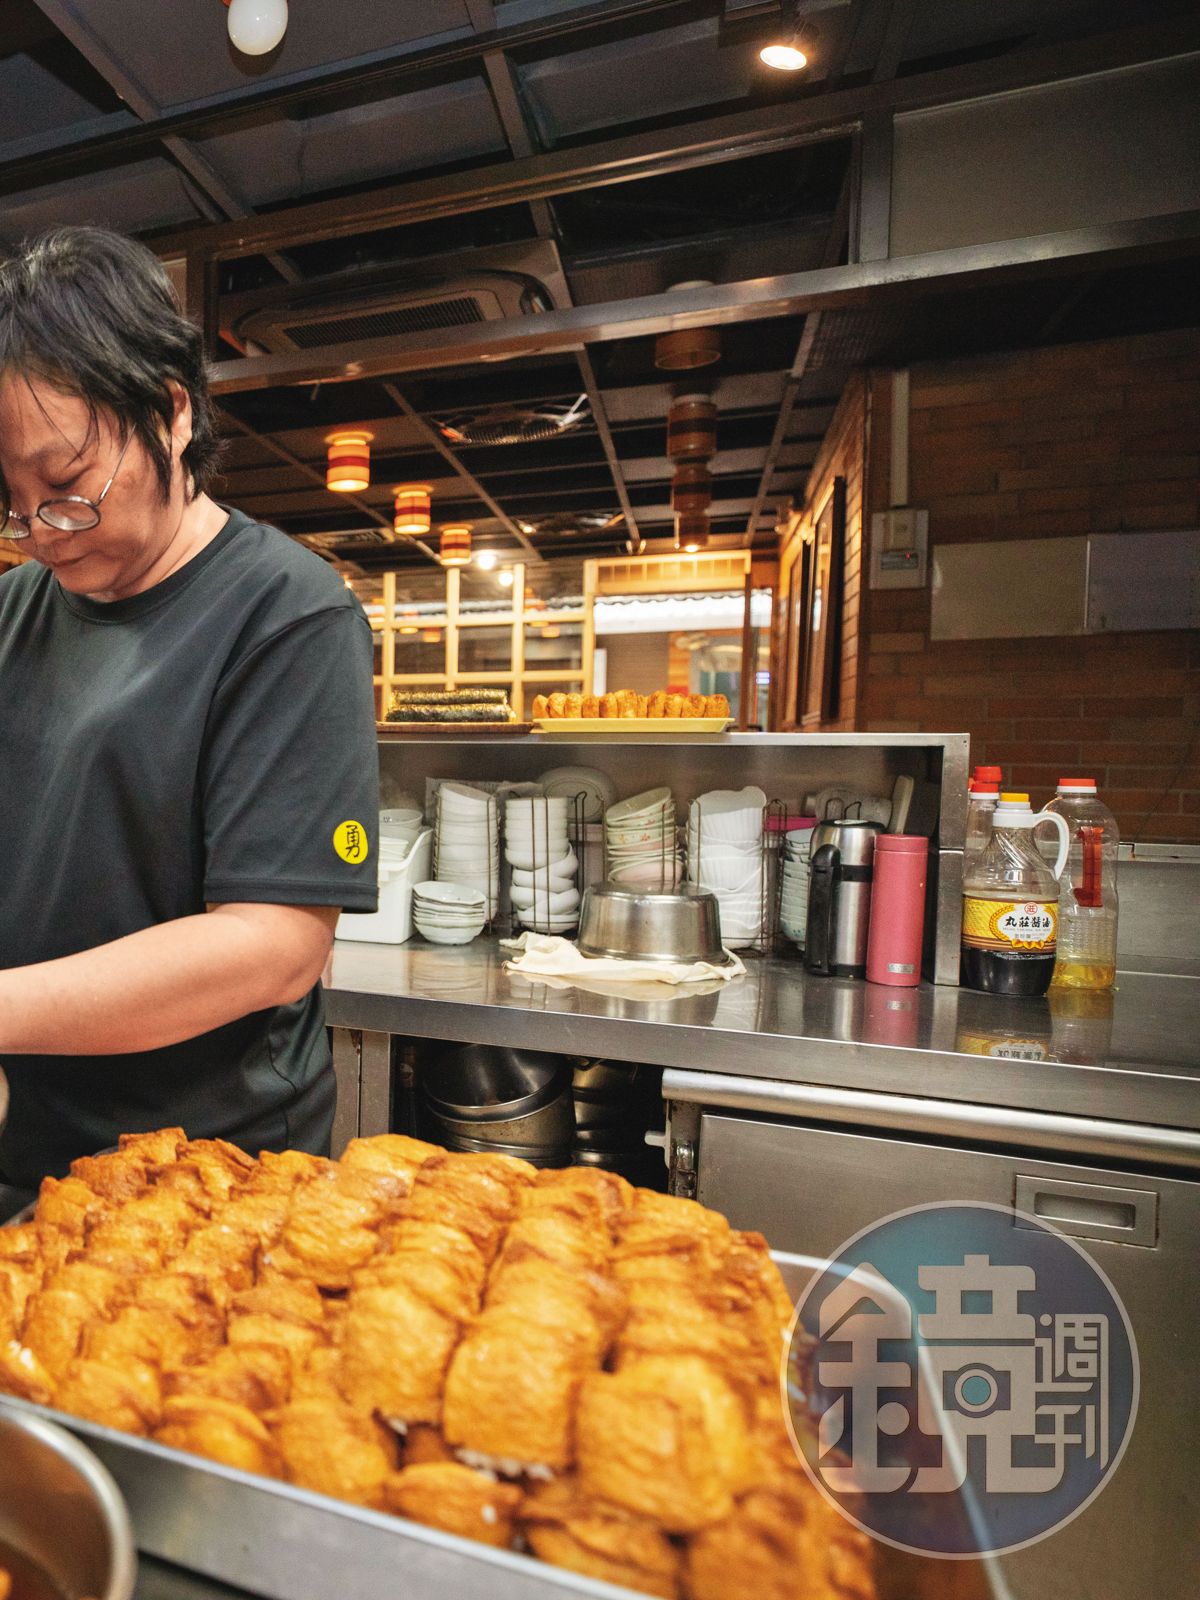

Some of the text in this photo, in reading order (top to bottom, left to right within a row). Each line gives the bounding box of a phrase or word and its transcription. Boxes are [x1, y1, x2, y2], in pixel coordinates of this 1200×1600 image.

[345, 824, 361, 858] 勇
[1005, 915, 1050, 928] 丸莊醬油
